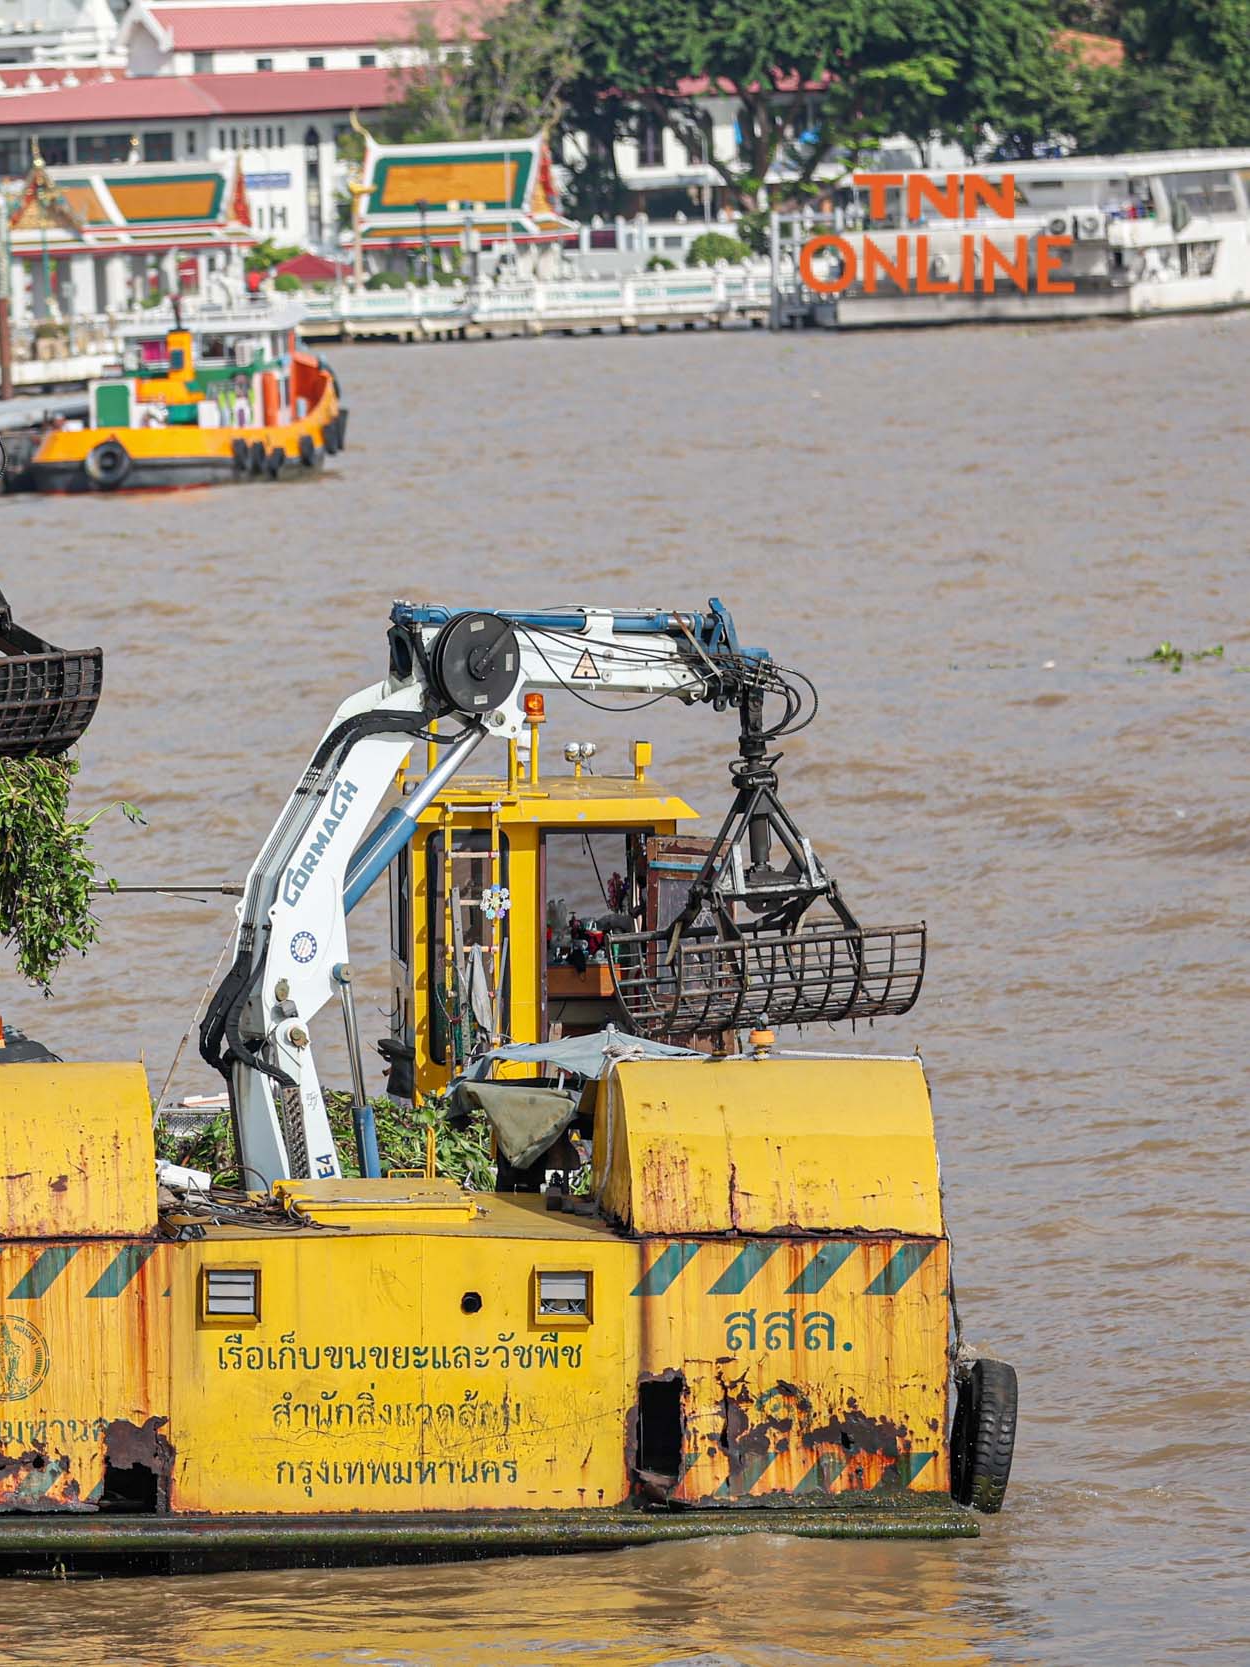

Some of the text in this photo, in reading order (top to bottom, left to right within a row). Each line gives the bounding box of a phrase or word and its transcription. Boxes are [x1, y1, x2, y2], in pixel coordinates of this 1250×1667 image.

[283, 779, 359, 907] CORMACH
[217, 1330, 583, 1371] เรือเก็บขนขยะและวัชพืช
[724, 1308, 853, 1351] สสล.
[276, 1458, 519, 1498] กรุงเทพมหานคร
